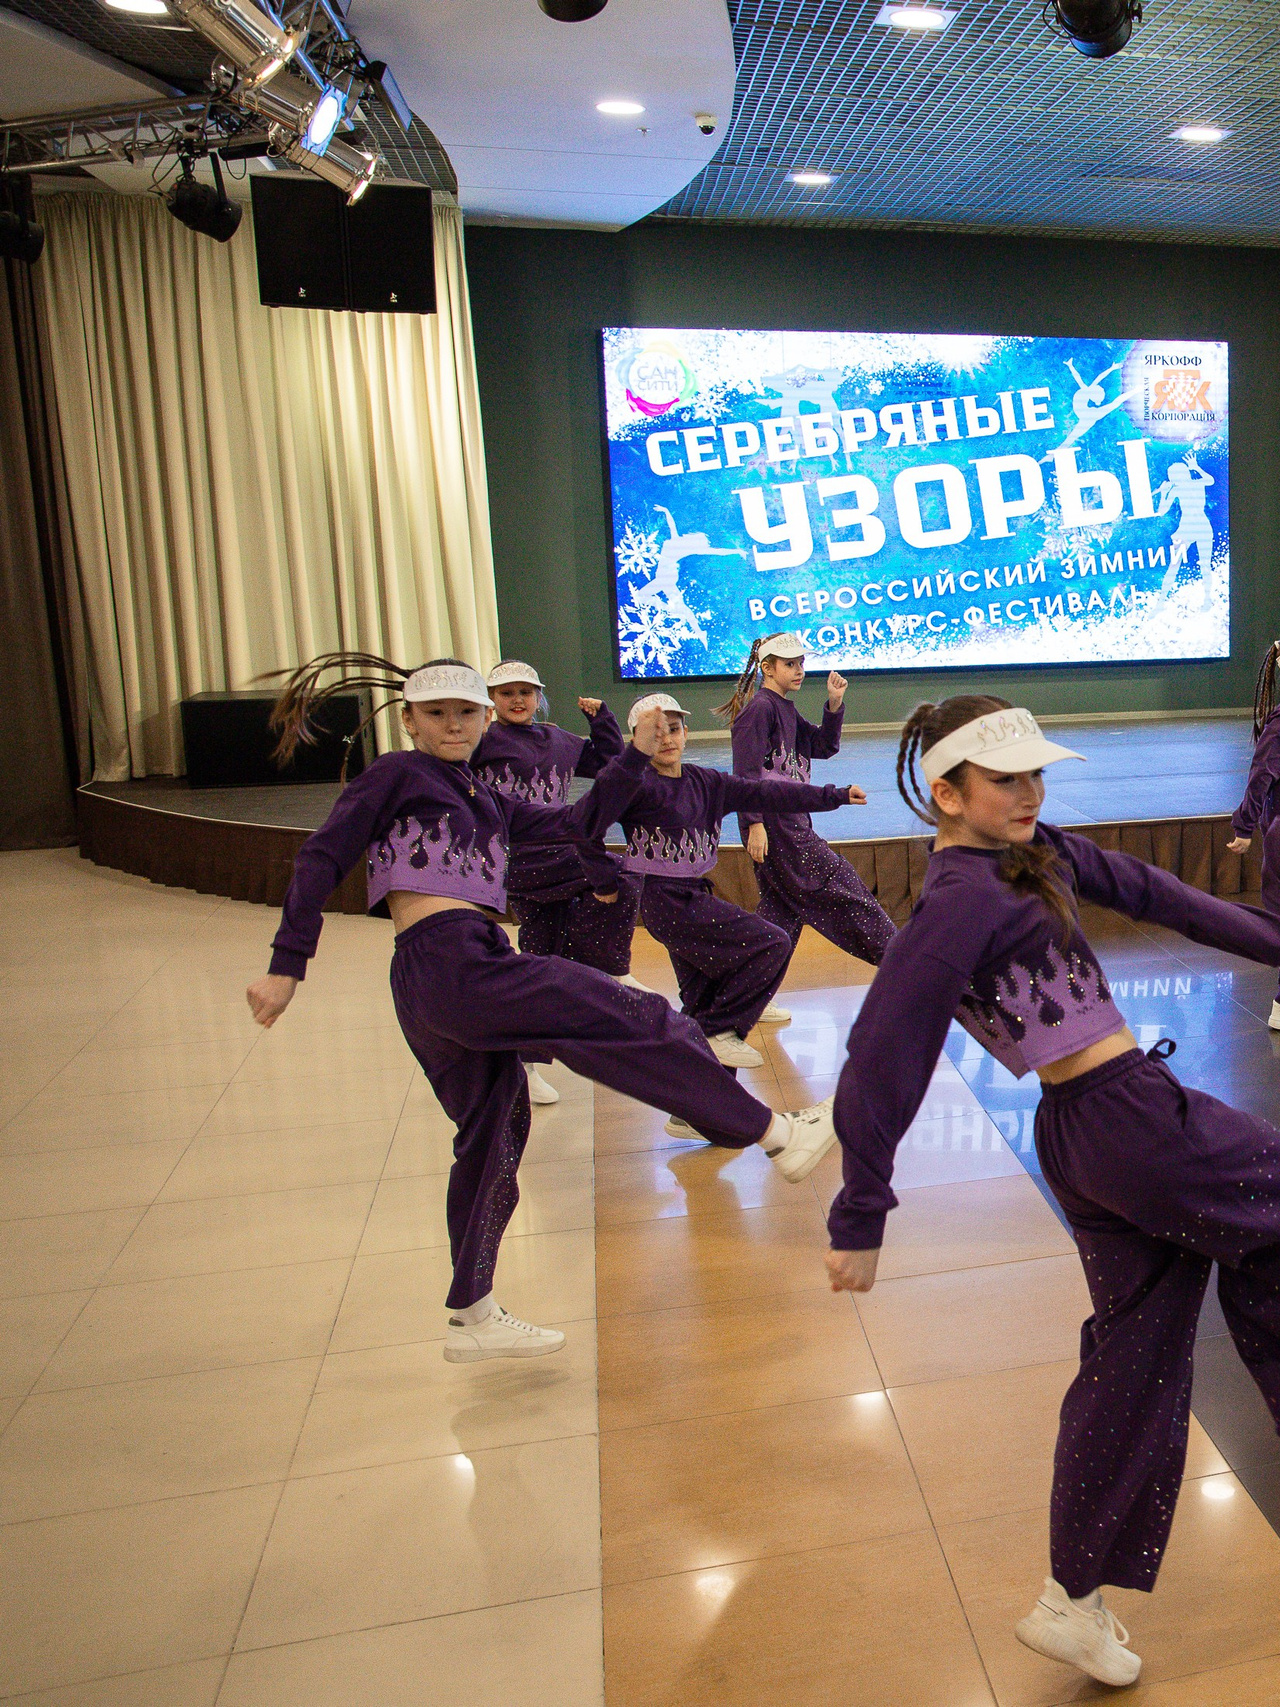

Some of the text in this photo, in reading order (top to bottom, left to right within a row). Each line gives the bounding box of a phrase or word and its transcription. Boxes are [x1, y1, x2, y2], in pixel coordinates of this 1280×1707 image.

[637, 365, 678, 381] САН
[1144, 354, 1203, 367] ЯРКОФФ
[637, 380, 679, 392] СИТИ
[645, 386, 1056, 477] СЕРЕБРЯНЫЕ
[1151, 411, 1216, 422] КОРПОРАЦИЯ
[731, 438, 1162, 573] УЗОРЫ
[748, 539, 1189, 621] ВСЕРОССИЙСКИЙ ЗИМНИЙ
[796, 584, 1149, 651] КОНКУРС-ФЕСТИВАЛЬ
